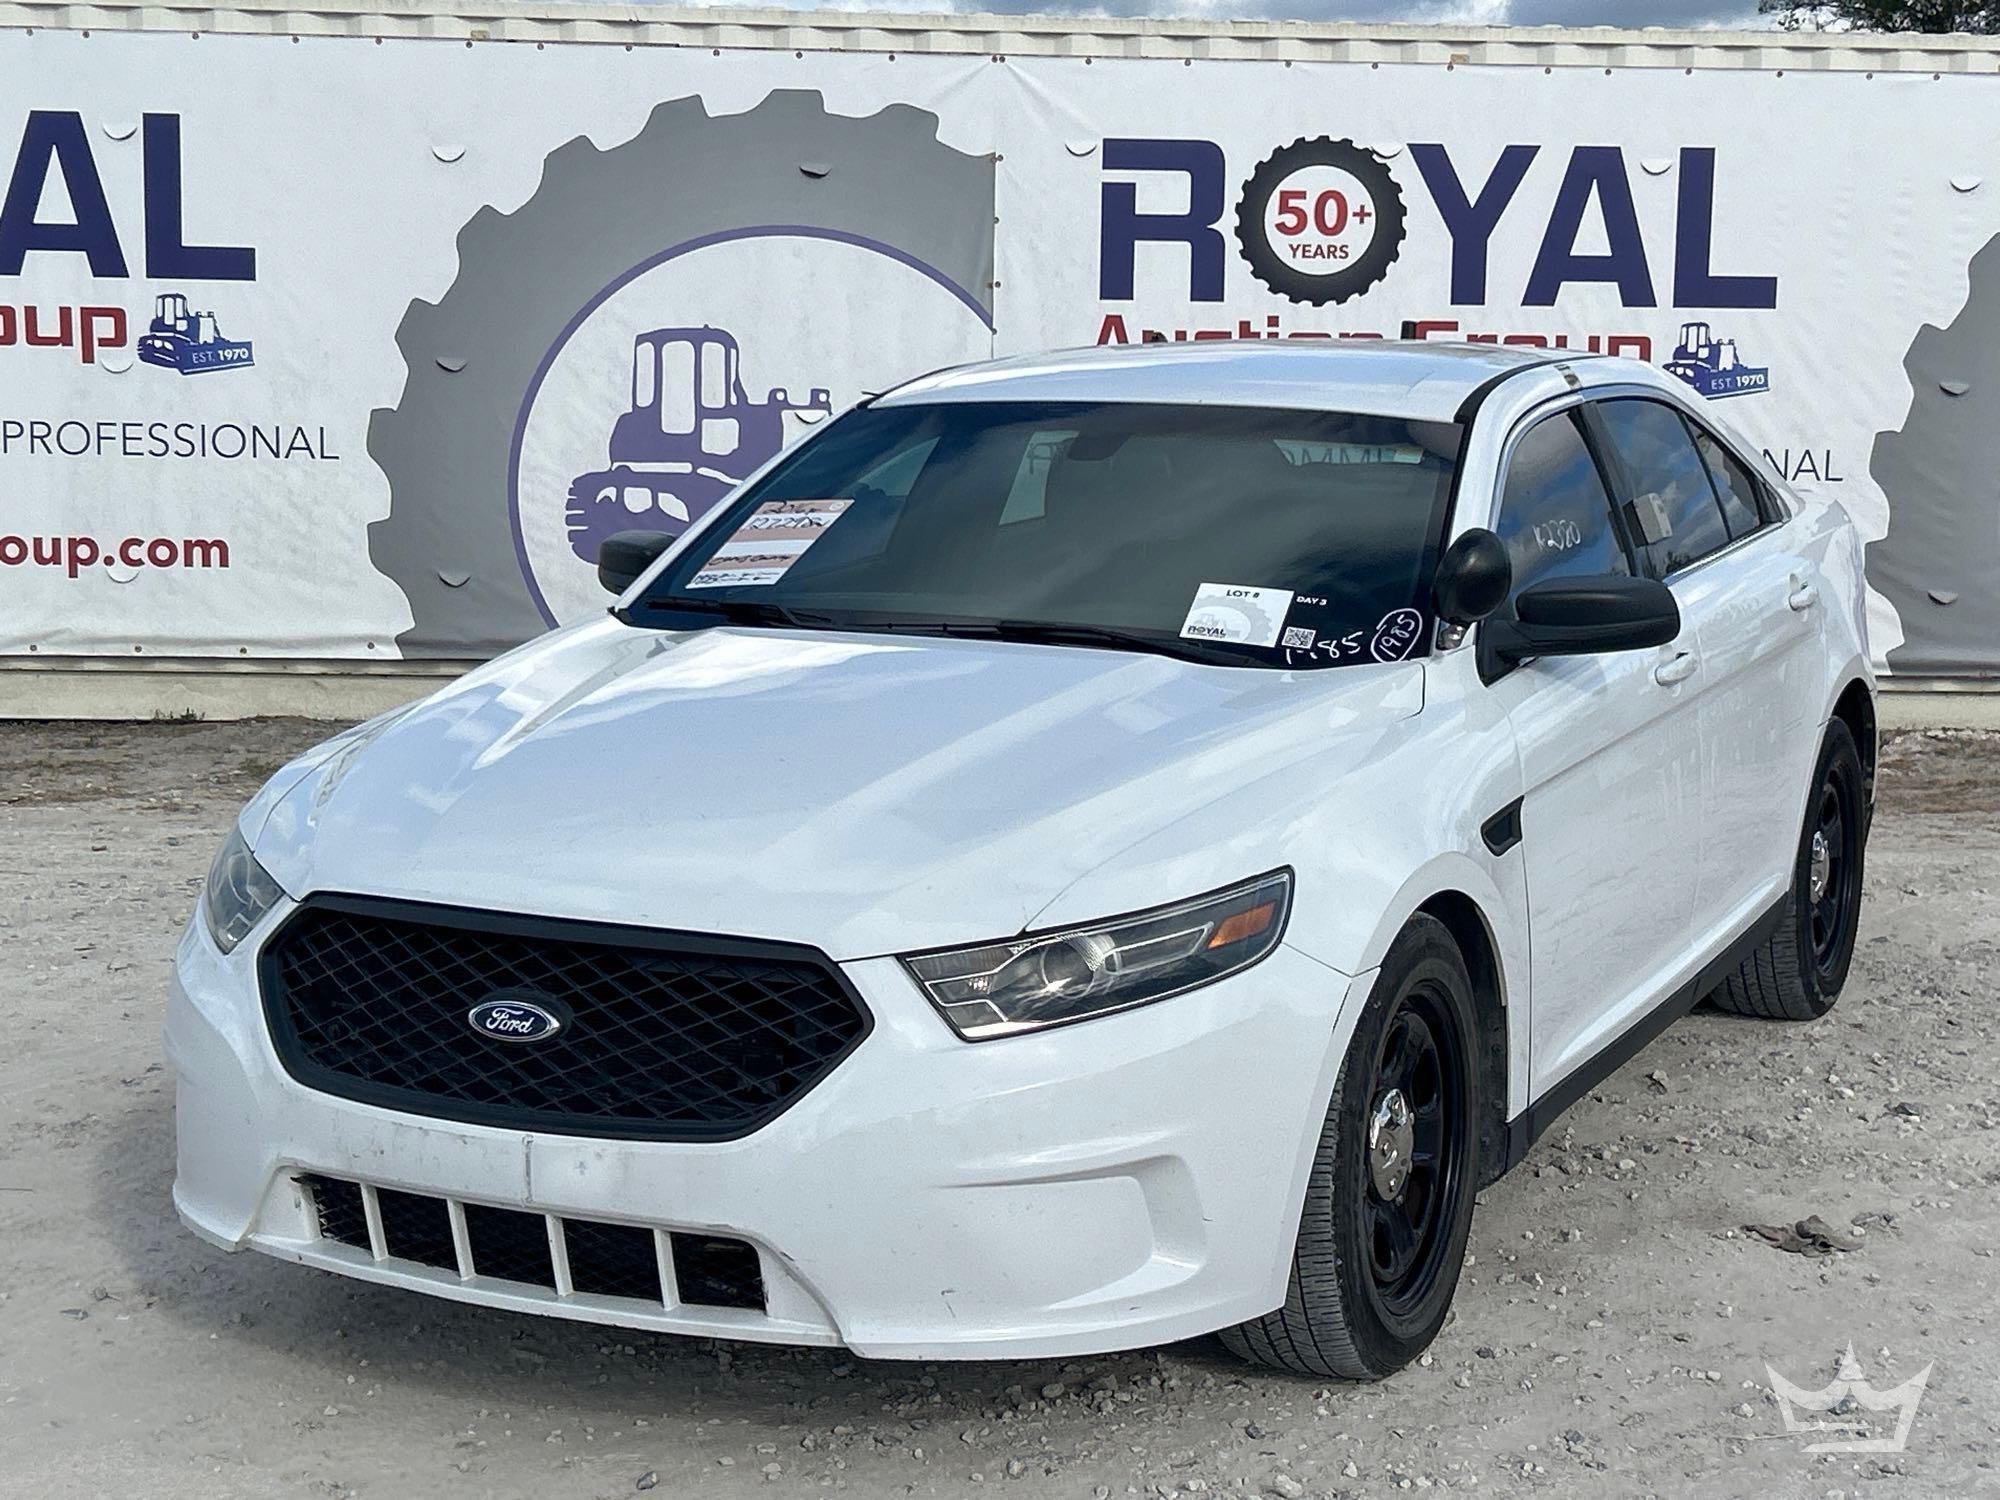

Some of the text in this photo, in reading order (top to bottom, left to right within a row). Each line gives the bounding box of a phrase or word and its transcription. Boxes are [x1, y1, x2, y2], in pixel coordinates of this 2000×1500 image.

[1274, 190, 1373, 236] 50+
[1100, 136, 1778, 309] ROYAL
[1288, 244, 1349, 259] YEARS
[218, 347, 249, 362] 1970
[1735, 373, 1765, 388] 1970
[2, 420, 340, 460] PROFESSIONAL
[1226, 589, 1251, 598] LOT
[1296, 596, 1319, 605] DAY
[1187, 625, 1227, 637] ROYAL
[1379, 614, 1416, 659] 1985
[485, 1007, 535, 1033] Ford
